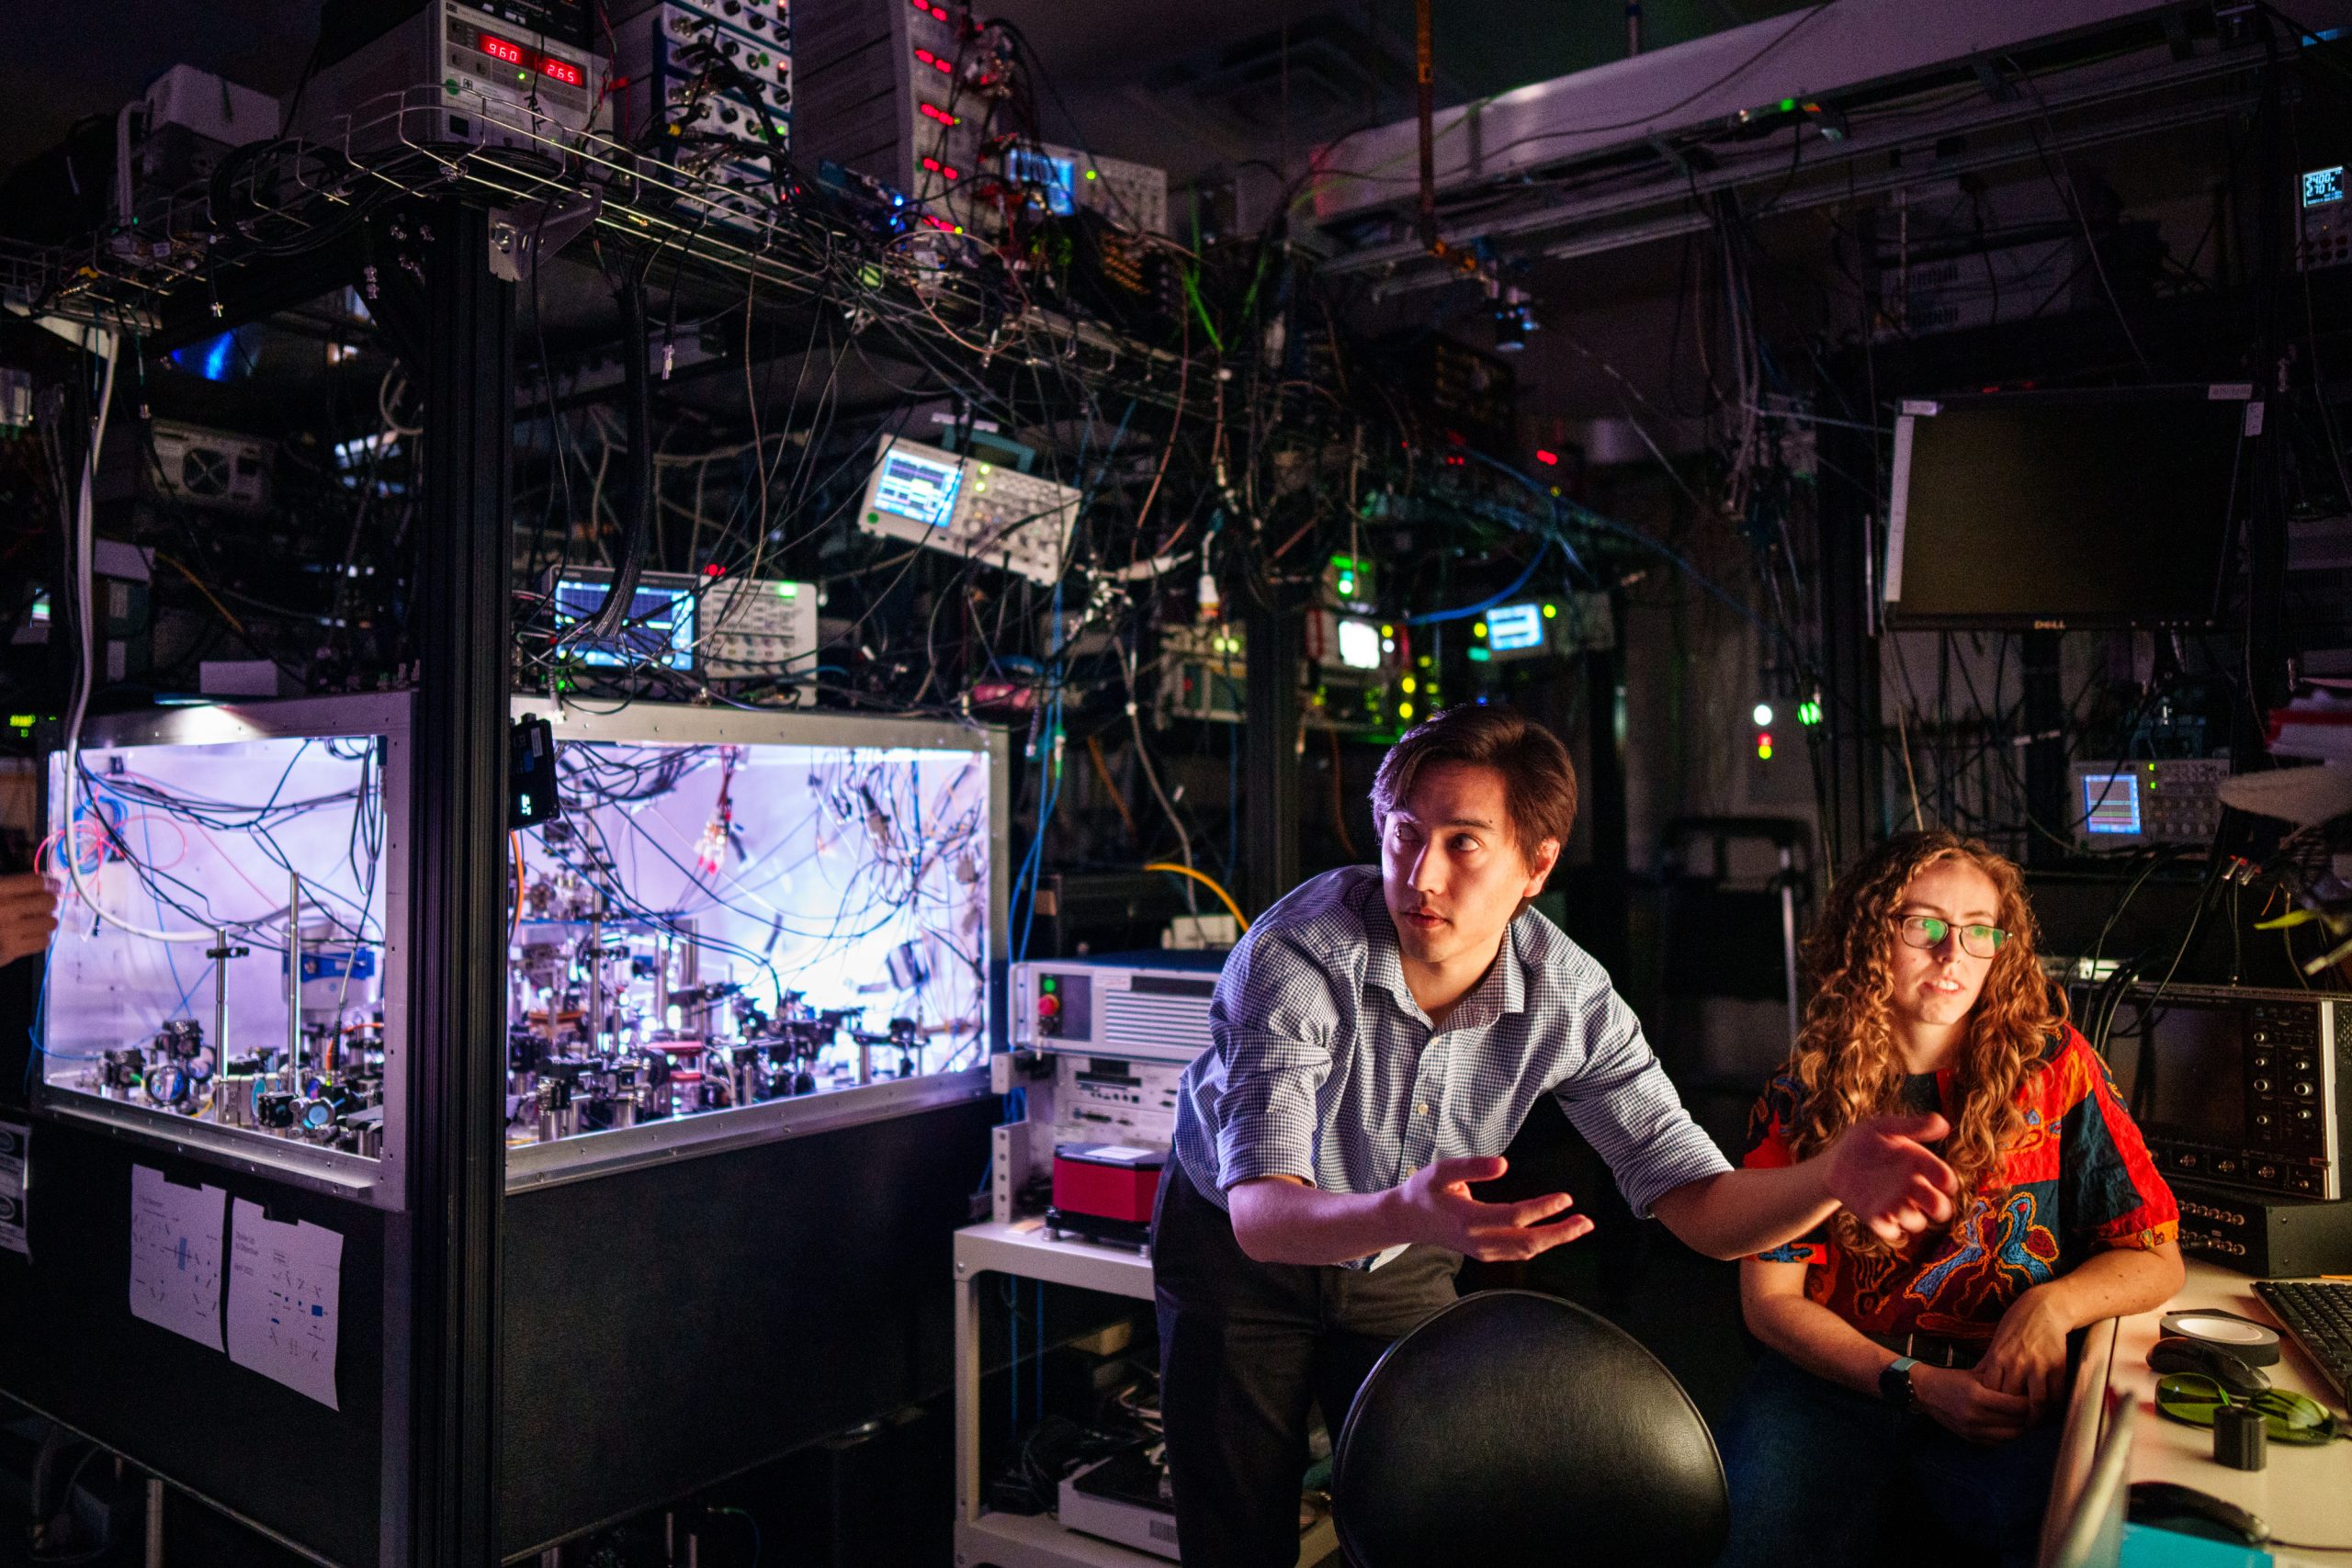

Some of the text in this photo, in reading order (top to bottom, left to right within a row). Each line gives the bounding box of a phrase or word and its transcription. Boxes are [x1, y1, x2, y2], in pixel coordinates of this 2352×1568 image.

[489, 43, 517, 62] 960
[548, 64, 574, 82] 265
[2033, 619, 2066, 630] DELL
